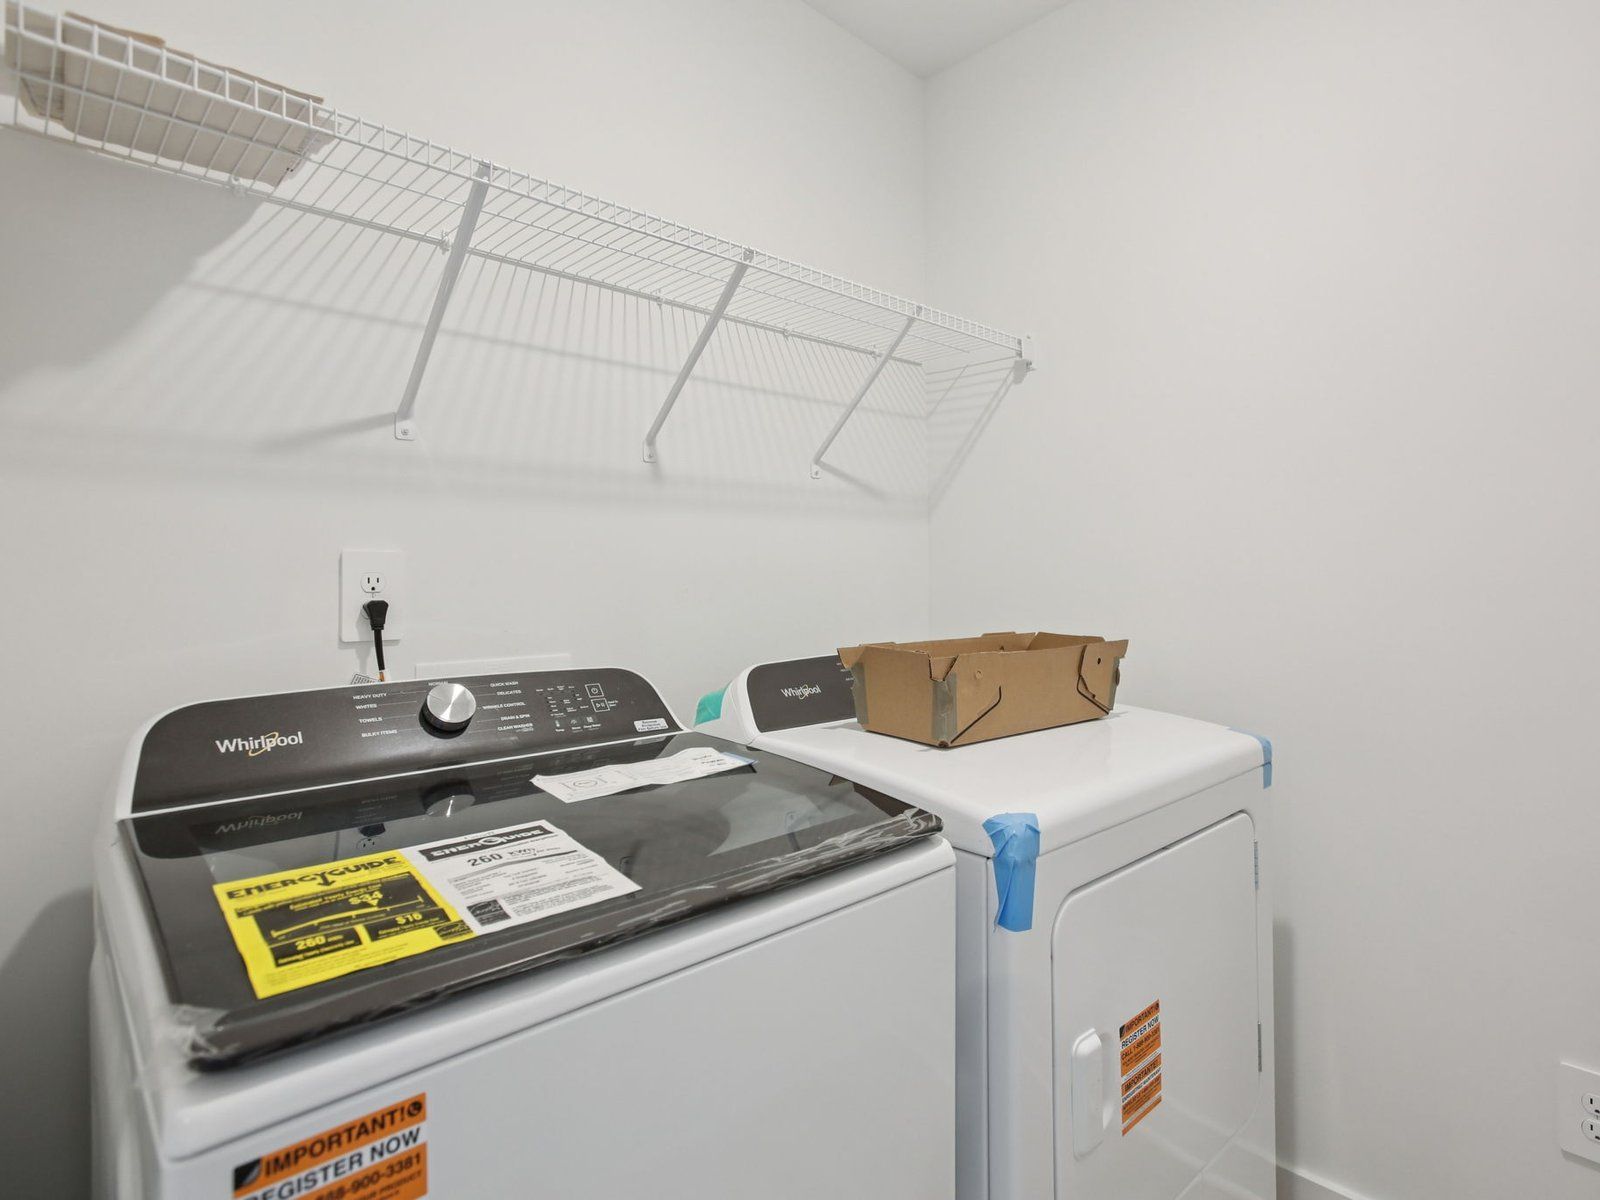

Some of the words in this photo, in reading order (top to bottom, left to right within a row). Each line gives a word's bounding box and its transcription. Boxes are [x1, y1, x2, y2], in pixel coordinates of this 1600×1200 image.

[780, 684, 822, 698] Whirlpool
[358, 716, 383, 724] TOWELS
[215, 731, 303, 756] Whirlpool
[467, 853, 503, 867] 260
[226, 856, 402, 899] ENERGYGUIDE
[1121, 1024, 1147, 1049] REGISTER
[1147, 1014, 1159, 1029] NOW
[1125, 1004, 1156, 1033] IMPORTANT!
[264, 1106, 405, 1176] IMPORTANT!
[244, 1152, 364, 1200] EGISTER
[370, 1127, 420, 1162] NOW
